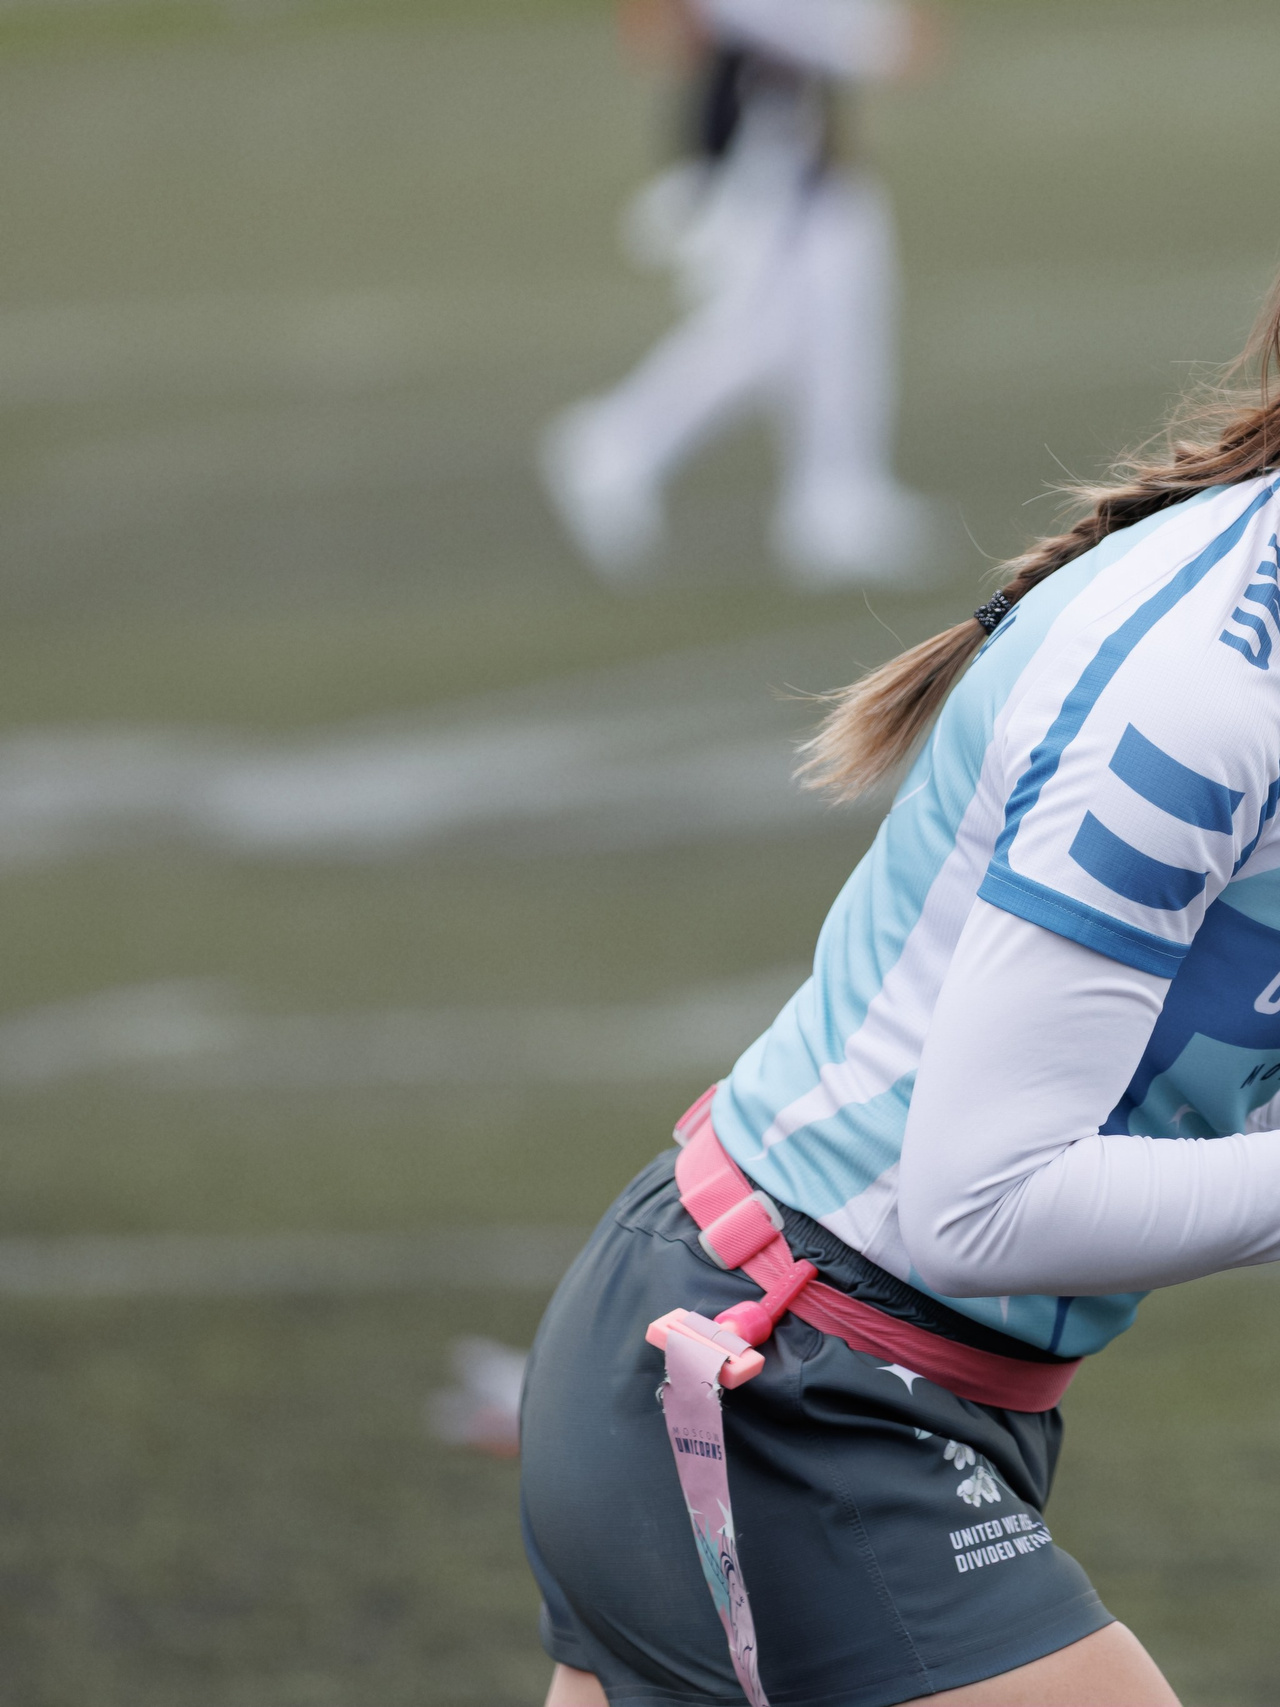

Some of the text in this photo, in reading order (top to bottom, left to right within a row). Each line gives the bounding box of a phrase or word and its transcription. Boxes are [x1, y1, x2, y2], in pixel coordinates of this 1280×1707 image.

[672, 1426, 720, 1442] MOSCOW
[675, 1437, 723, 1461] UNICORNS
[949, 1519, 1003, 1550] UNITED
[1001, 1514, 1021, 1535] WE
[954, 1540, 1016, 1573] DIVIDED
[1013, 1536, 1035, 1555] WE
